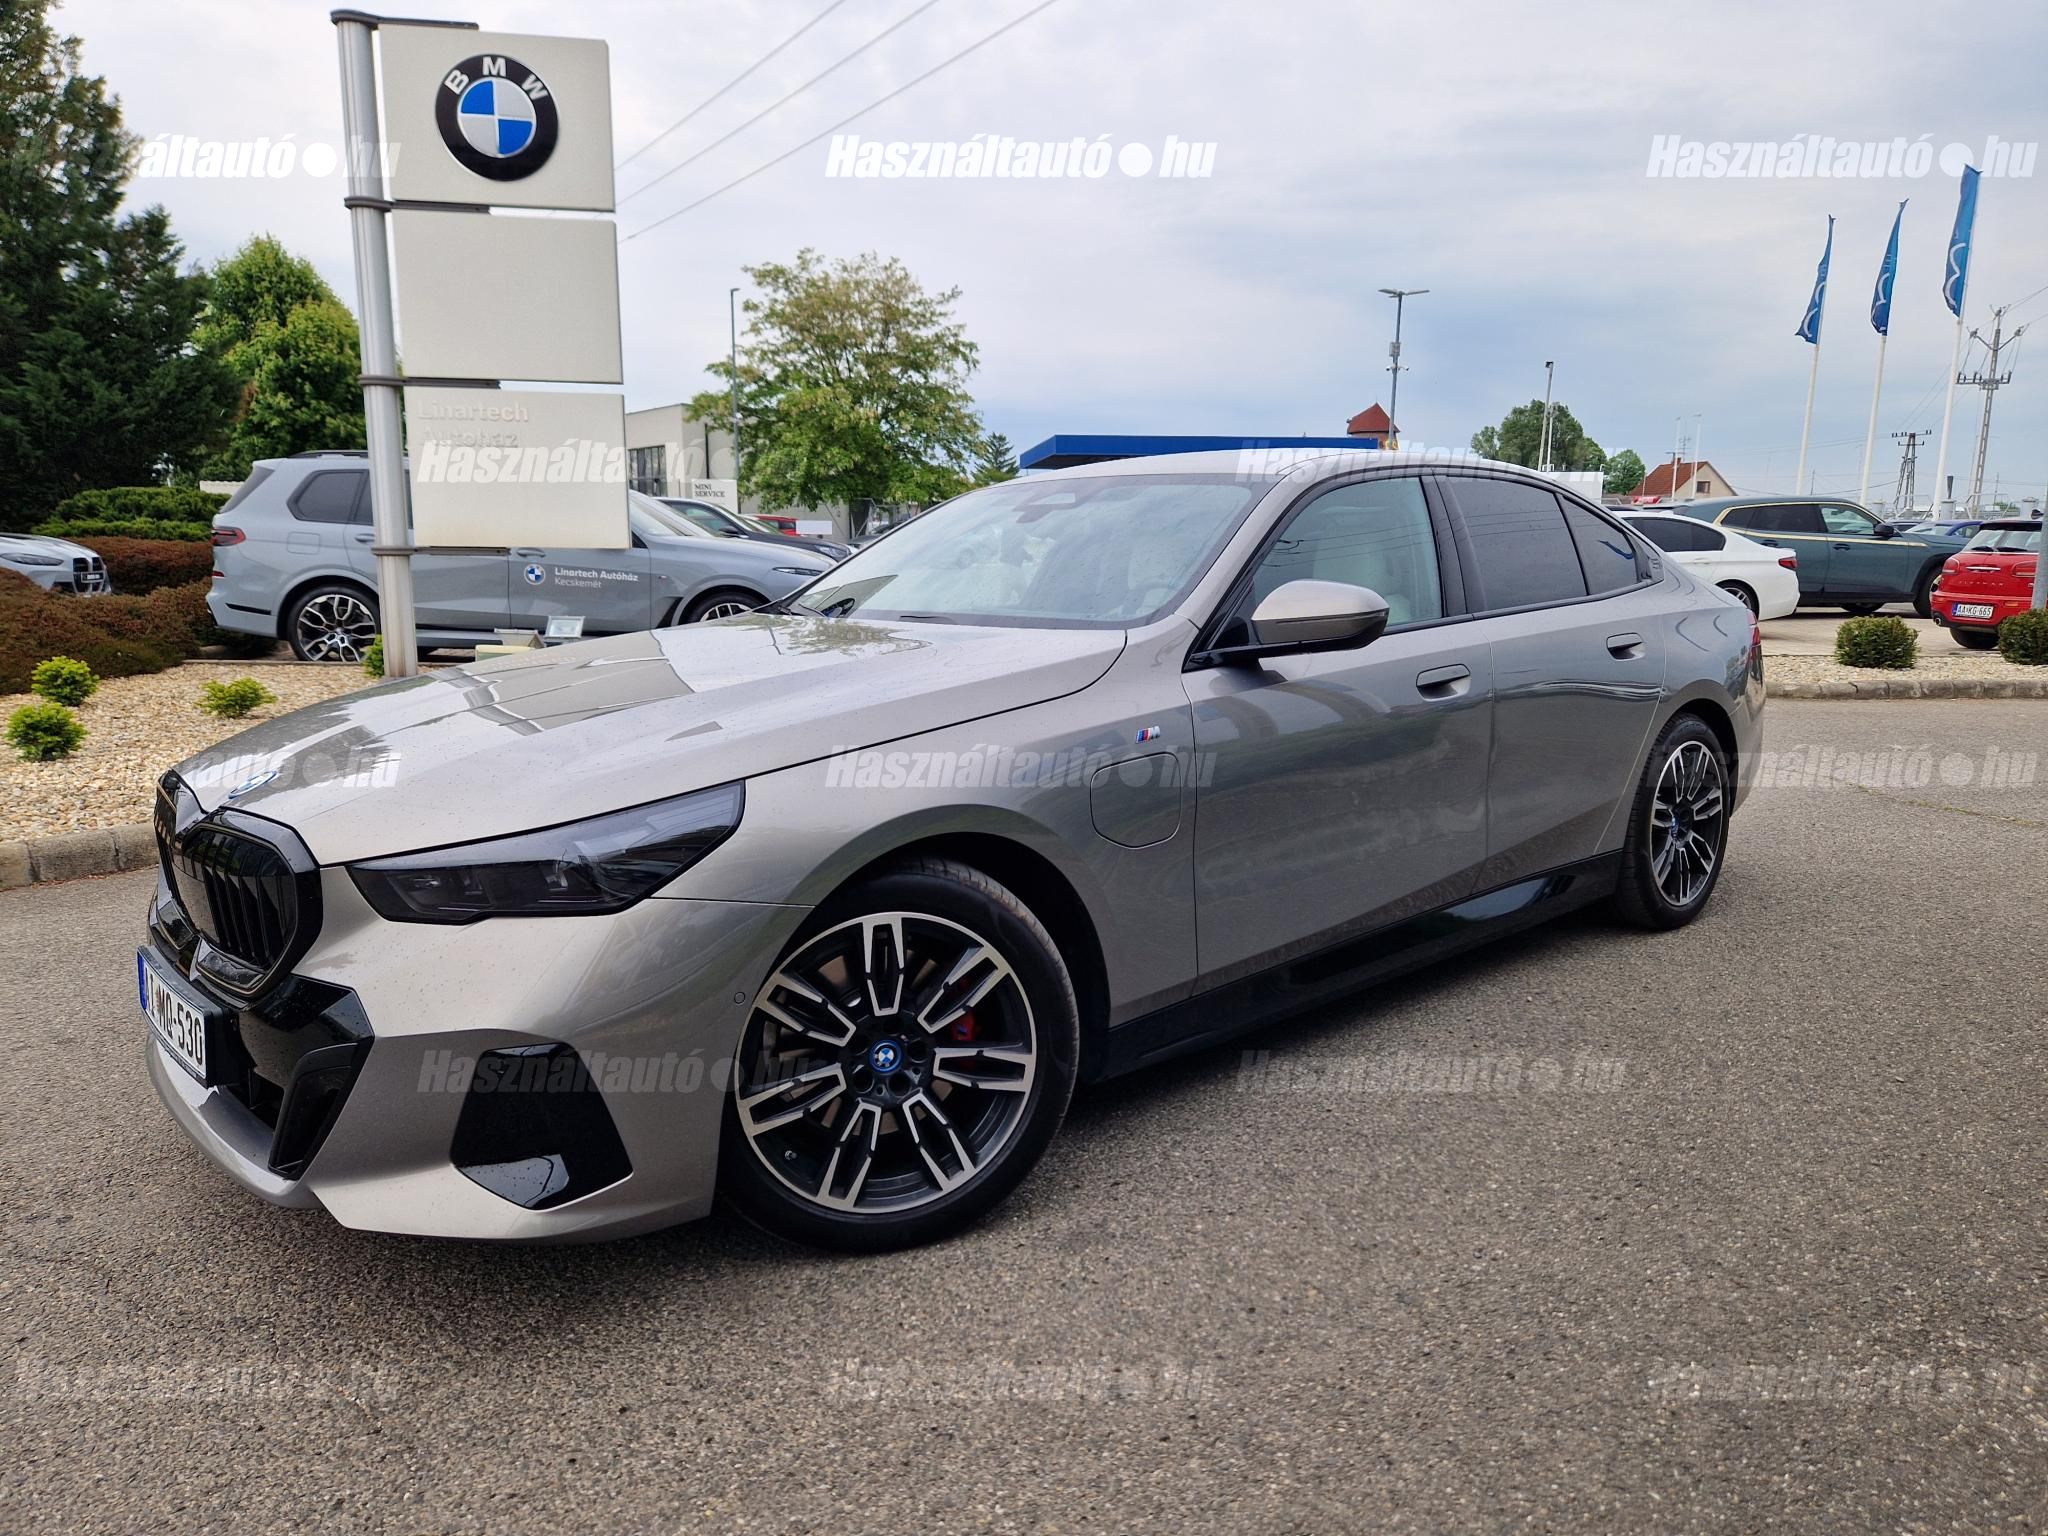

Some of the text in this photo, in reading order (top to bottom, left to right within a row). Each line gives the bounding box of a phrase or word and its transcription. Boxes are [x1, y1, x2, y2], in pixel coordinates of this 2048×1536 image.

[445, 56, 549, 101] BMW
[419, 400, 528, 422] Linartech
[695, 483, 712, 491] MINI
[695, 490, 725, 498] SERVICE
[554, 567, 639, 582] Linartech Autóház
[554, 578, 602, 589] Kecskemét
